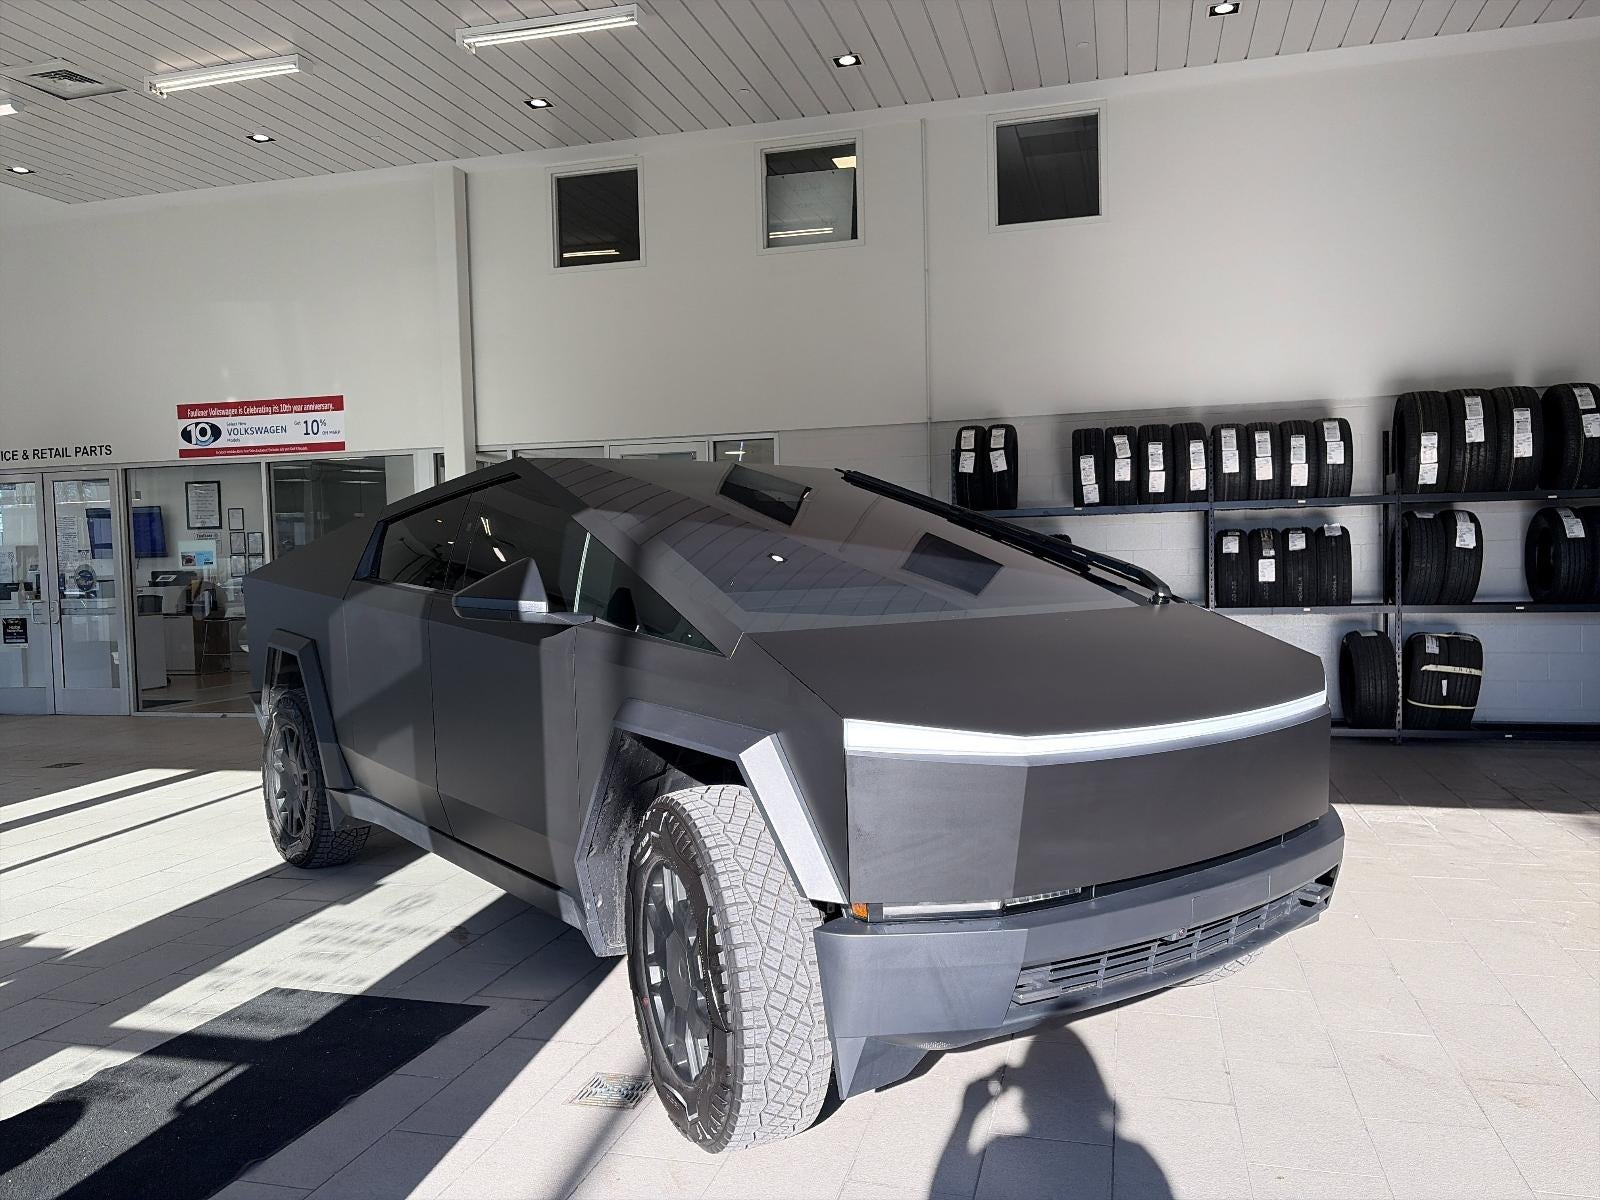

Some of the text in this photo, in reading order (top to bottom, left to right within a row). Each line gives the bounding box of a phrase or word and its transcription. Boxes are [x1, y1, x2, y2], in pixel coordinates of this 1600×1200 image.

[187, 409, 208, 417] Faulkner
[209, 407, 237, 417] Volkswagen
[238, 405, 243, 414] is
[243, 405, 271, 415] Celebrating
[280, 403, 291, 412] 10th
[292, 404, 303, 414] year
[186, 422, 212, 445] 10
[227, 425, 287, 436] VOLKSWAGEN
[1, 444, 112, 461] ICE & RETAIL PARTS
